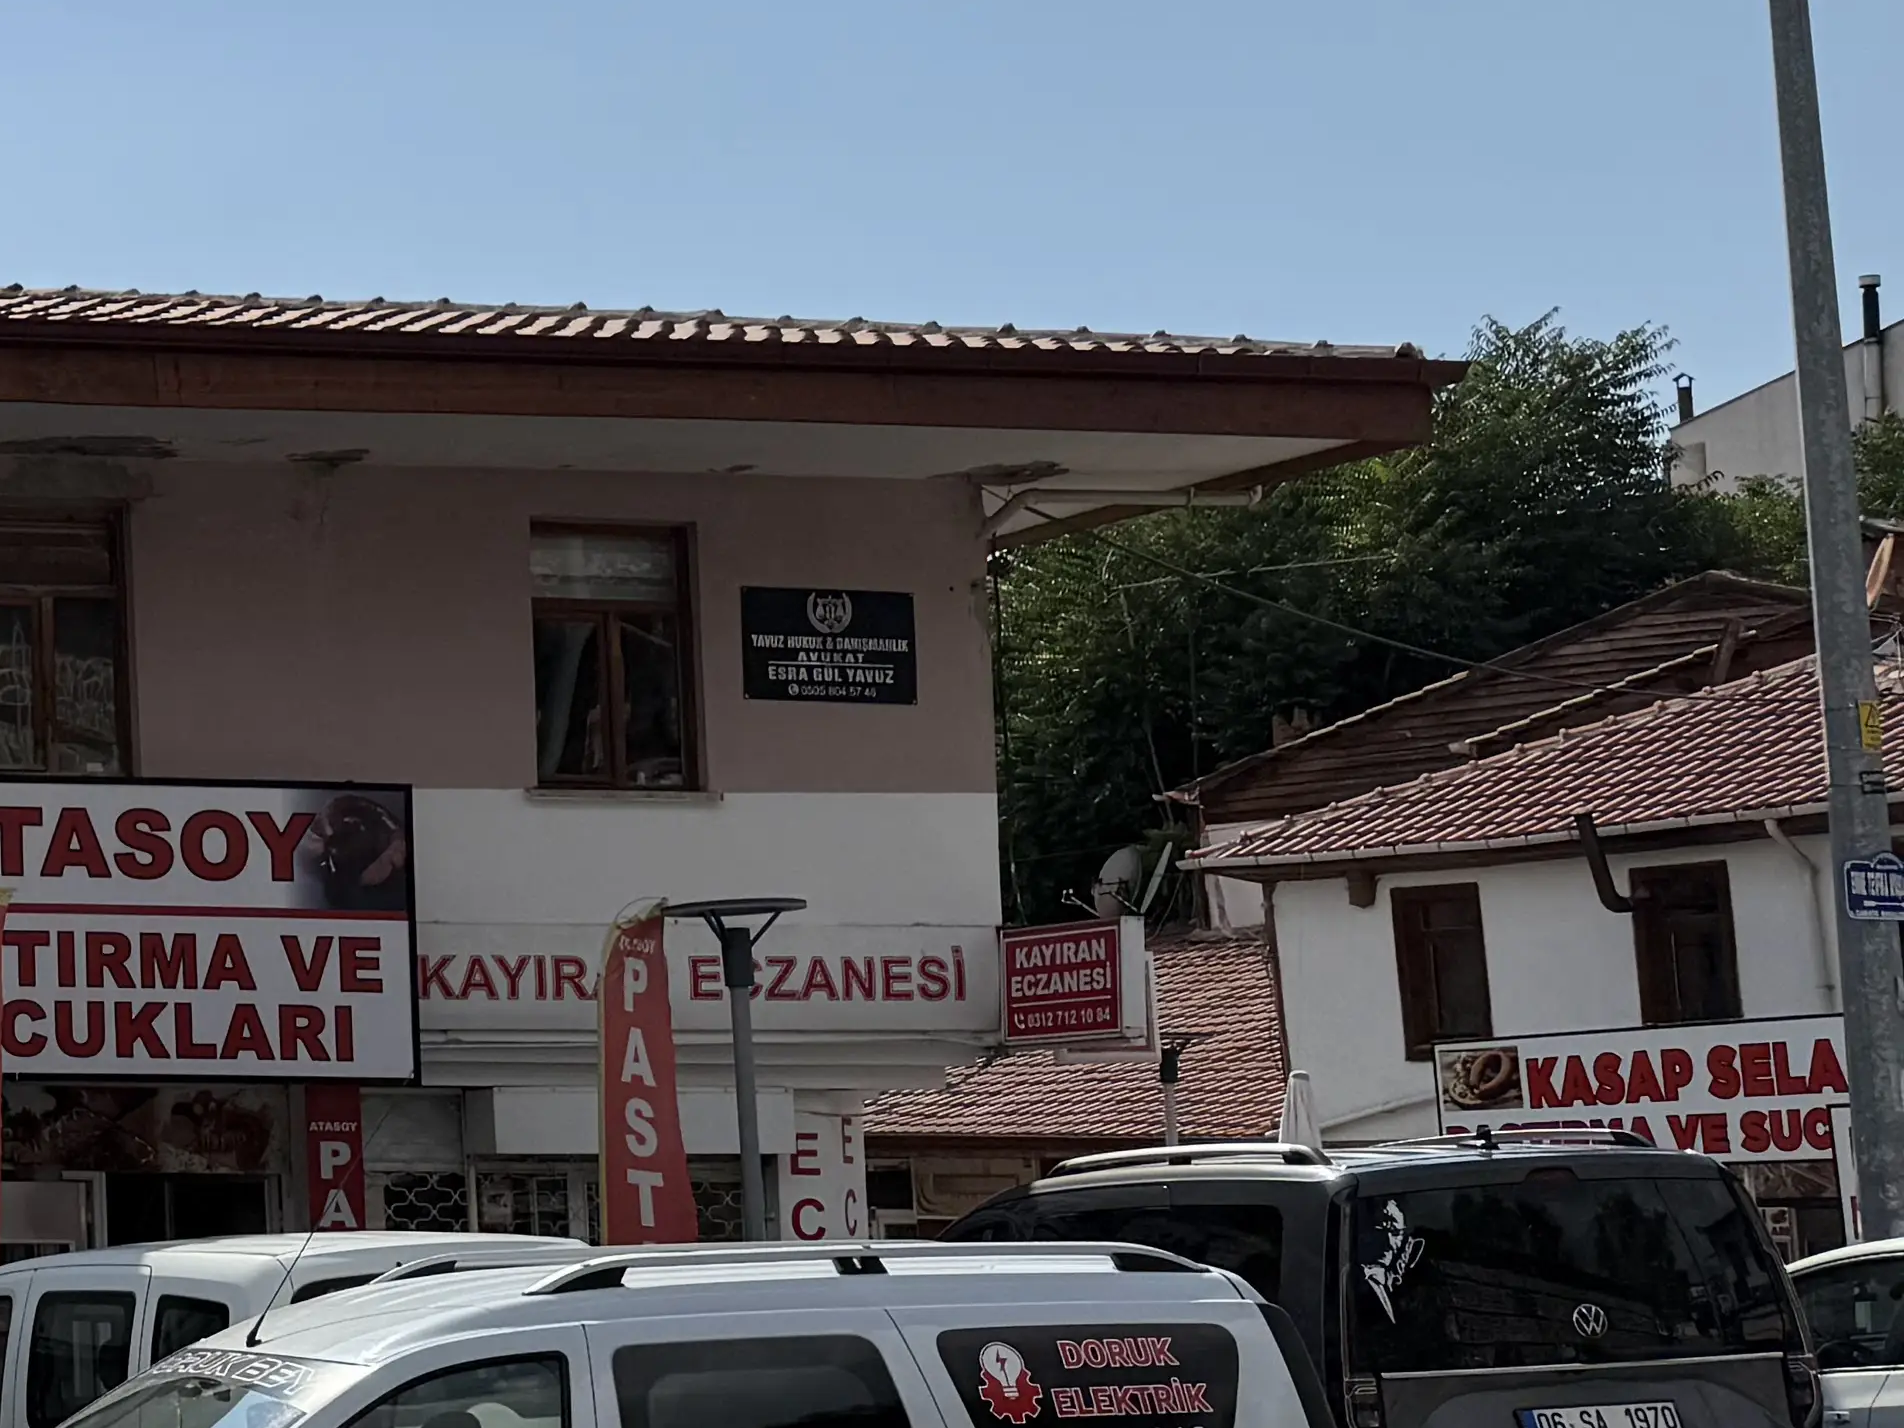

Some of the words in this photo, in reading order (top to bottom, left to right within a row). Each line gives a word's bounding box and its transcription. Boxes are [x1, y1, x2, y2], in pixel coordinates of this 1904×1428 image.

[751, 634, 785, 649] YAVUZ
[797, 651, 865, 663] AVUKAT
[768, 665, 809, 681] ESRA
[847, 668, 894, 684] YAVUZ
[281, 936, 384, 994] VE
[1014, 938, 1106, 969] KAYIRAN
[417, 953, 600, 1003] KAYIR
[1010, 960, 1113, 998] ECZANESİ
[1526, 1047, 1694, 1109] KASAP
[1666, 1114, 1731, 1155] VE
[1056, 1336, 1180, 1369] DORUK
[1050, 1376, 1214, 1418] ELEKTRİK
